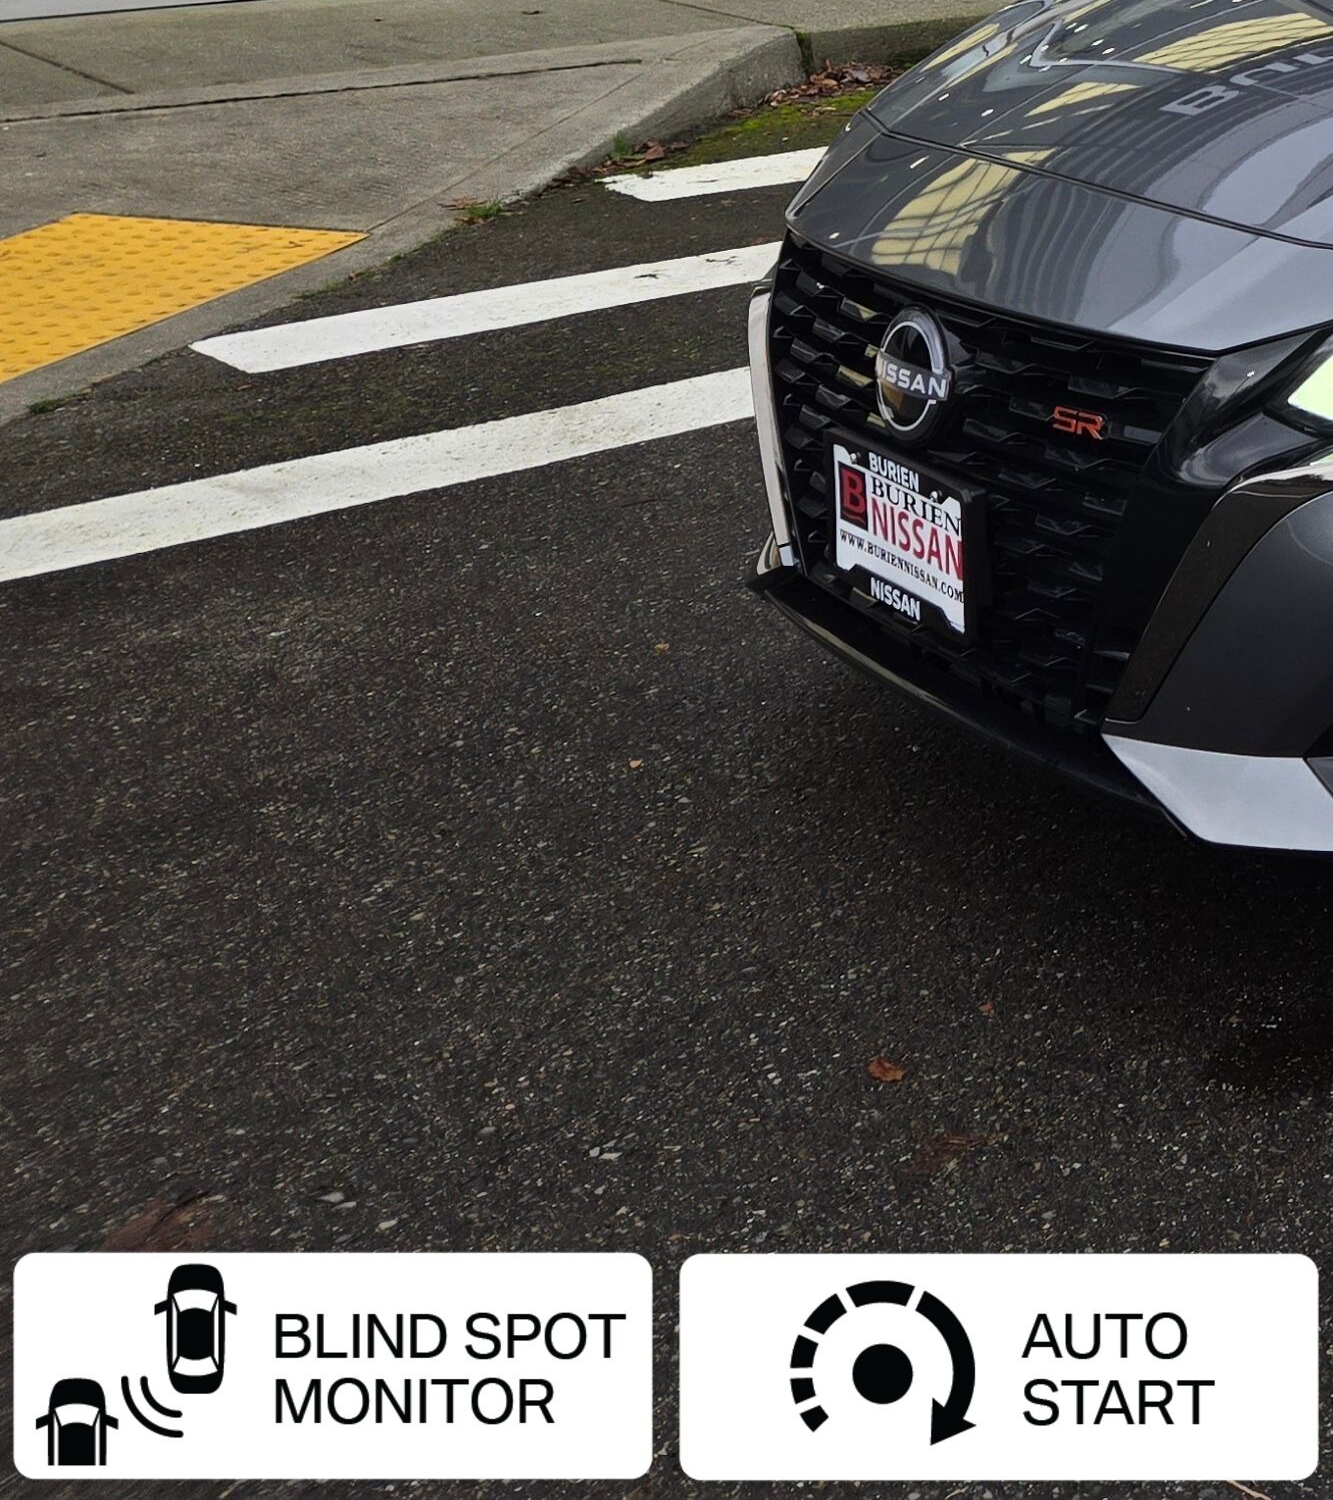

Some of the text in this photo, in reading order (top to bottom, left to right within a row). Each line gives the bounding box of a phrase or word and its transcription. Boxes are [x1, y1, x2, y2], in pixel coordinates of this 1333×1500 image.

[879, 356, 947, 399] ISSAN
[1052, 405, 1104, 441] SR
[868, 451, 920, 493] BURIEN
[871, 475, 962, 537] BURIEN
[871, 498, 964, 581] NISSAN
[840, 530, 965, 604] WWW.BURIENNISSAN.COM
[870, 576, 921, 621] NISSAN
